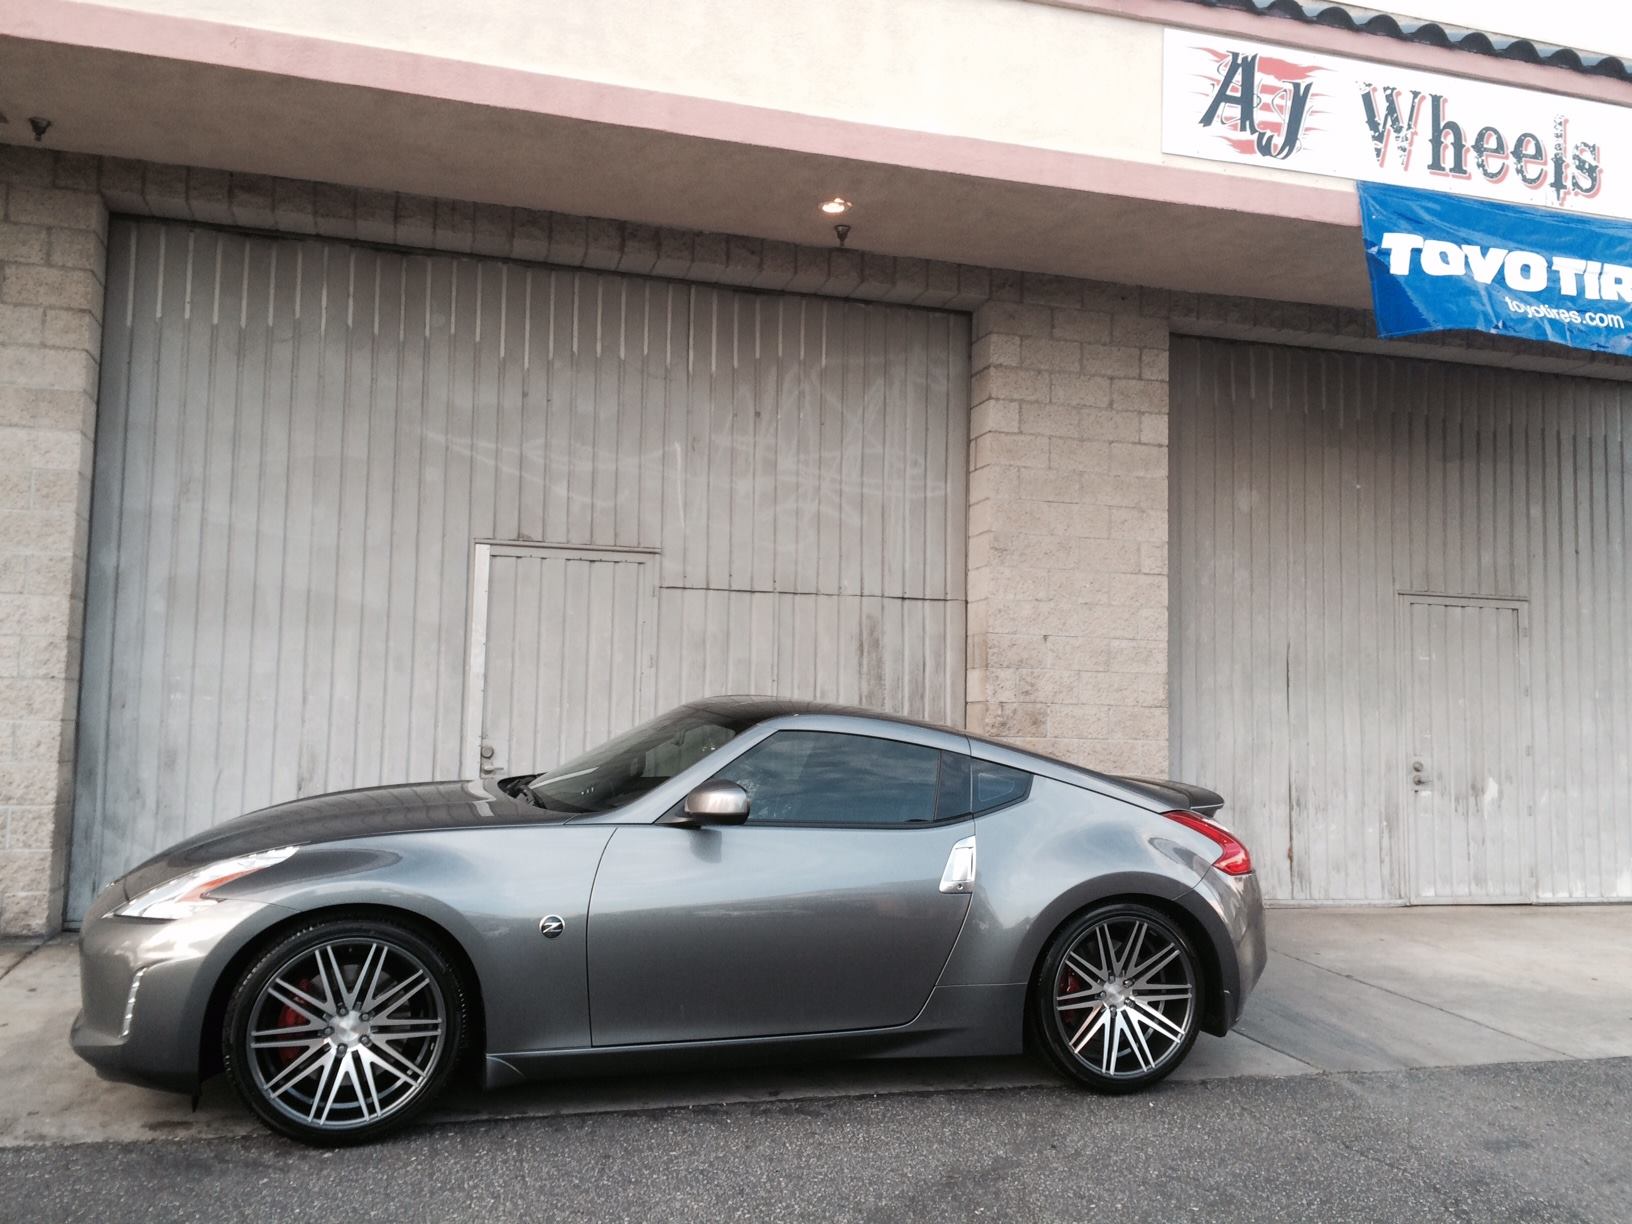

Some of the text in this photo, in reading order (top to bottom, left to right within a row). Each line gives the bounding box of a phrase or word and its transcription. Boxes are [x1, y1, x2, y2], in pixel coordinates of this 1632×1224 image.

[1355, 82, 1603, 206] Wheels
[1381, 232, 1549, 292] TOYO
[1505, 296, 1624, 329] toyotires.com
